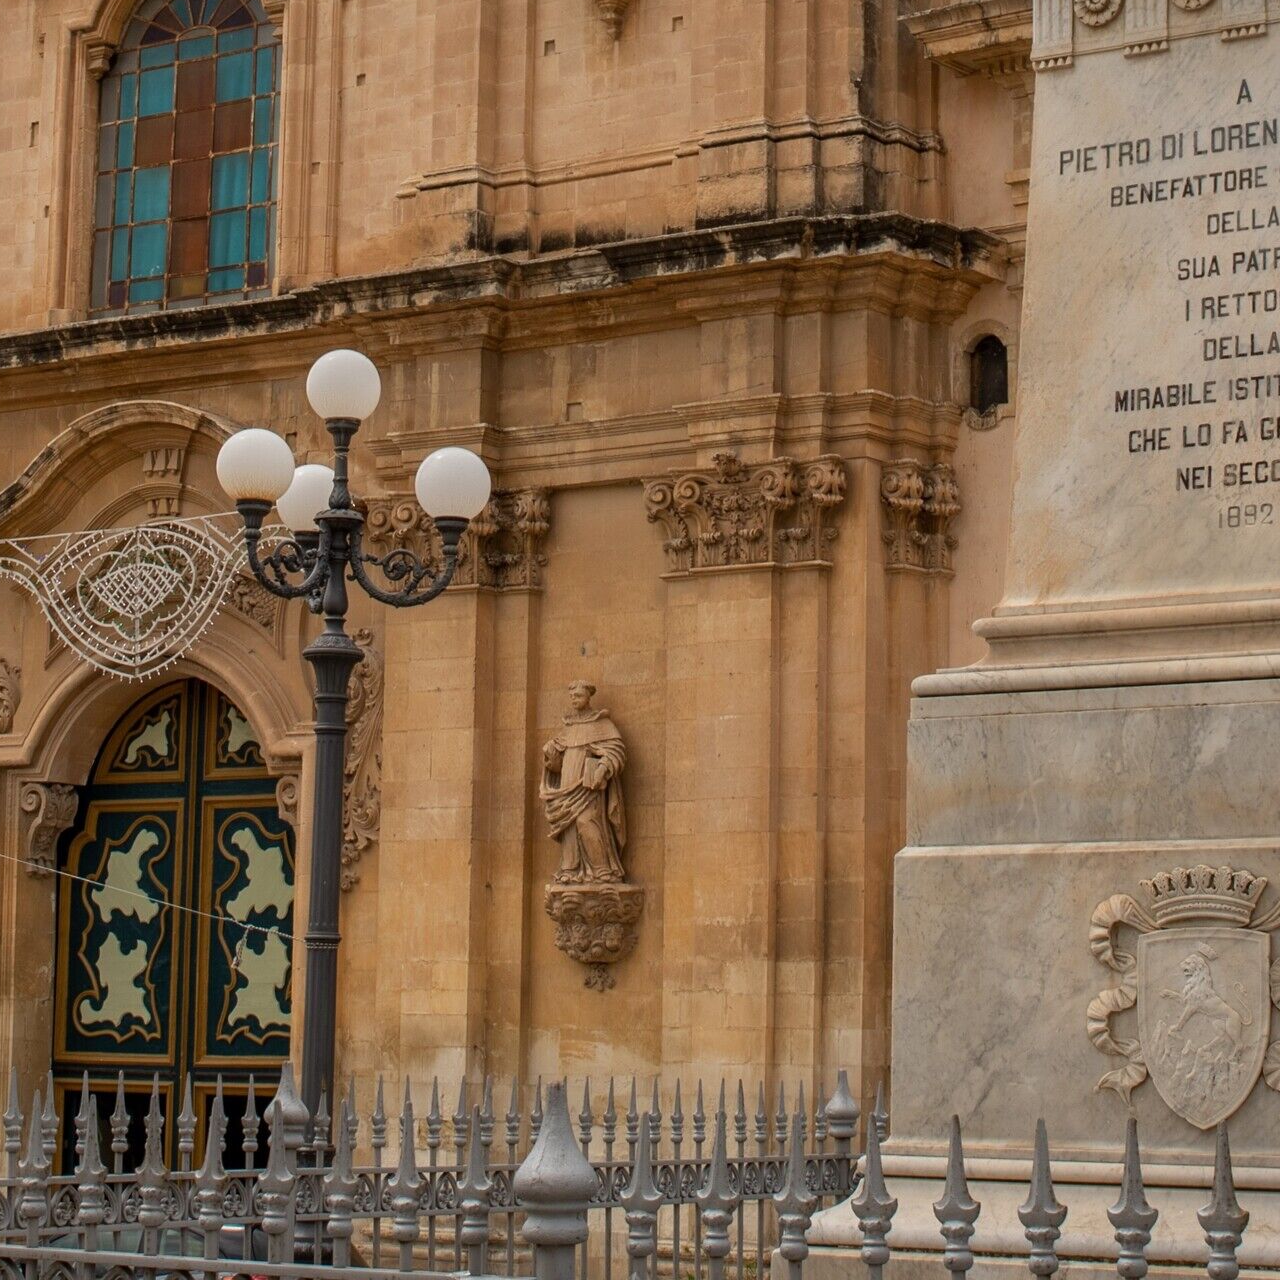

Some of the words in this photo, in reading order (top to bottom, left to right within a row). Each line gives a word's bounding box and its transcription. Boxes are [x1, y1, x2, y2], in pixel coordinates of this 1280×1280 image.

[1236, 78, 1252, 105] A
[1059, 137, 1150, 175] PIETRO
[1161, 132, 1183, 161] DI
[1110, 165, 1268, 208] BENEFATTORE
[1207, 205, 1280, 235] DELLA
[1177, 255, 1220, 281] SUA
[1185, 299, 1190, 321] I
[1203, 331, 1280, 361] DELLA
[1114, 380, 1217, 412] MIRABILE
[1128, 427, 1171, 453] CHE
[1182, 423, 1211, 448] LO
[1222, 420, 1248, 444] FA
[1175, 465, 1212, 491] NEI
[1218, 503, 1274, 529] 1892
